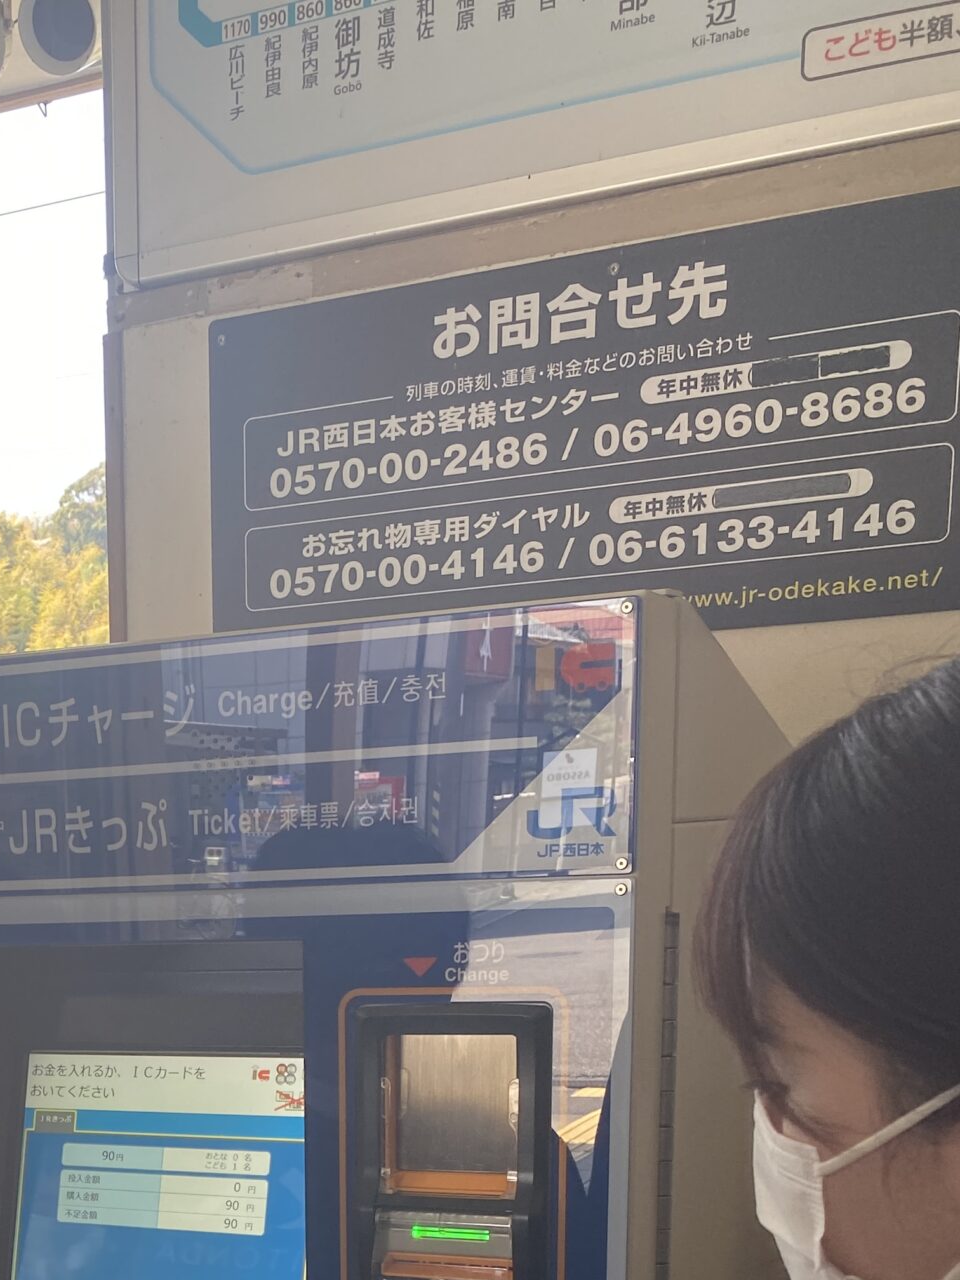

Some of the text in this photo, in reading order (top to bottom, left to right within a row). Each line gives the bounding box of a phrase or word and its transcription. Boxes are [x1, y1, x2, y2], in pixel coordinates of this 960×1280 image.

[224, 19, 251, 39] 1170
[260, 10, 287, 30] 990
[296, 1, 324, 20] 860
[377, 6, 396, 70] 道成寺
[416, 0, 435, 41] 和佐
[610, 13, 656, 32] Minabe
[691, 26, 750, 48] Kii-Tanabe
[265, 35, 281, 98] 紀伊由良
[302, 26, 319, 90] 紀伊内原
[334, 16, 361, 80] 御坊
[228, 45, 245, 121] 広川ビーチ
[433, 260, 728, 359] お問合せ先
[270, 432, 548, 498] 0570-00-2486
[593, 377, 926, 457] 06-4960-8686
[277, 388, 619, 457] JR西日本お客様センター
[270, 541, 545, 599] 0570-00-4146
[589, 499, 917, 567] 06-6133-4146
[302, 502, 590, 558] お忘れ物専用ダイヤル
[2, 683, 196, 748] ICチャージ
[9, 799, 168, 856] JRきっぷ
[445, 967, 510, 984] Change
[453, 941, 505, 964] おつり
[30, 1085, 116, 1099] おいてください
[224, 1218, 238, 1229] 90
[225, 1200, 239, 1211] 90
